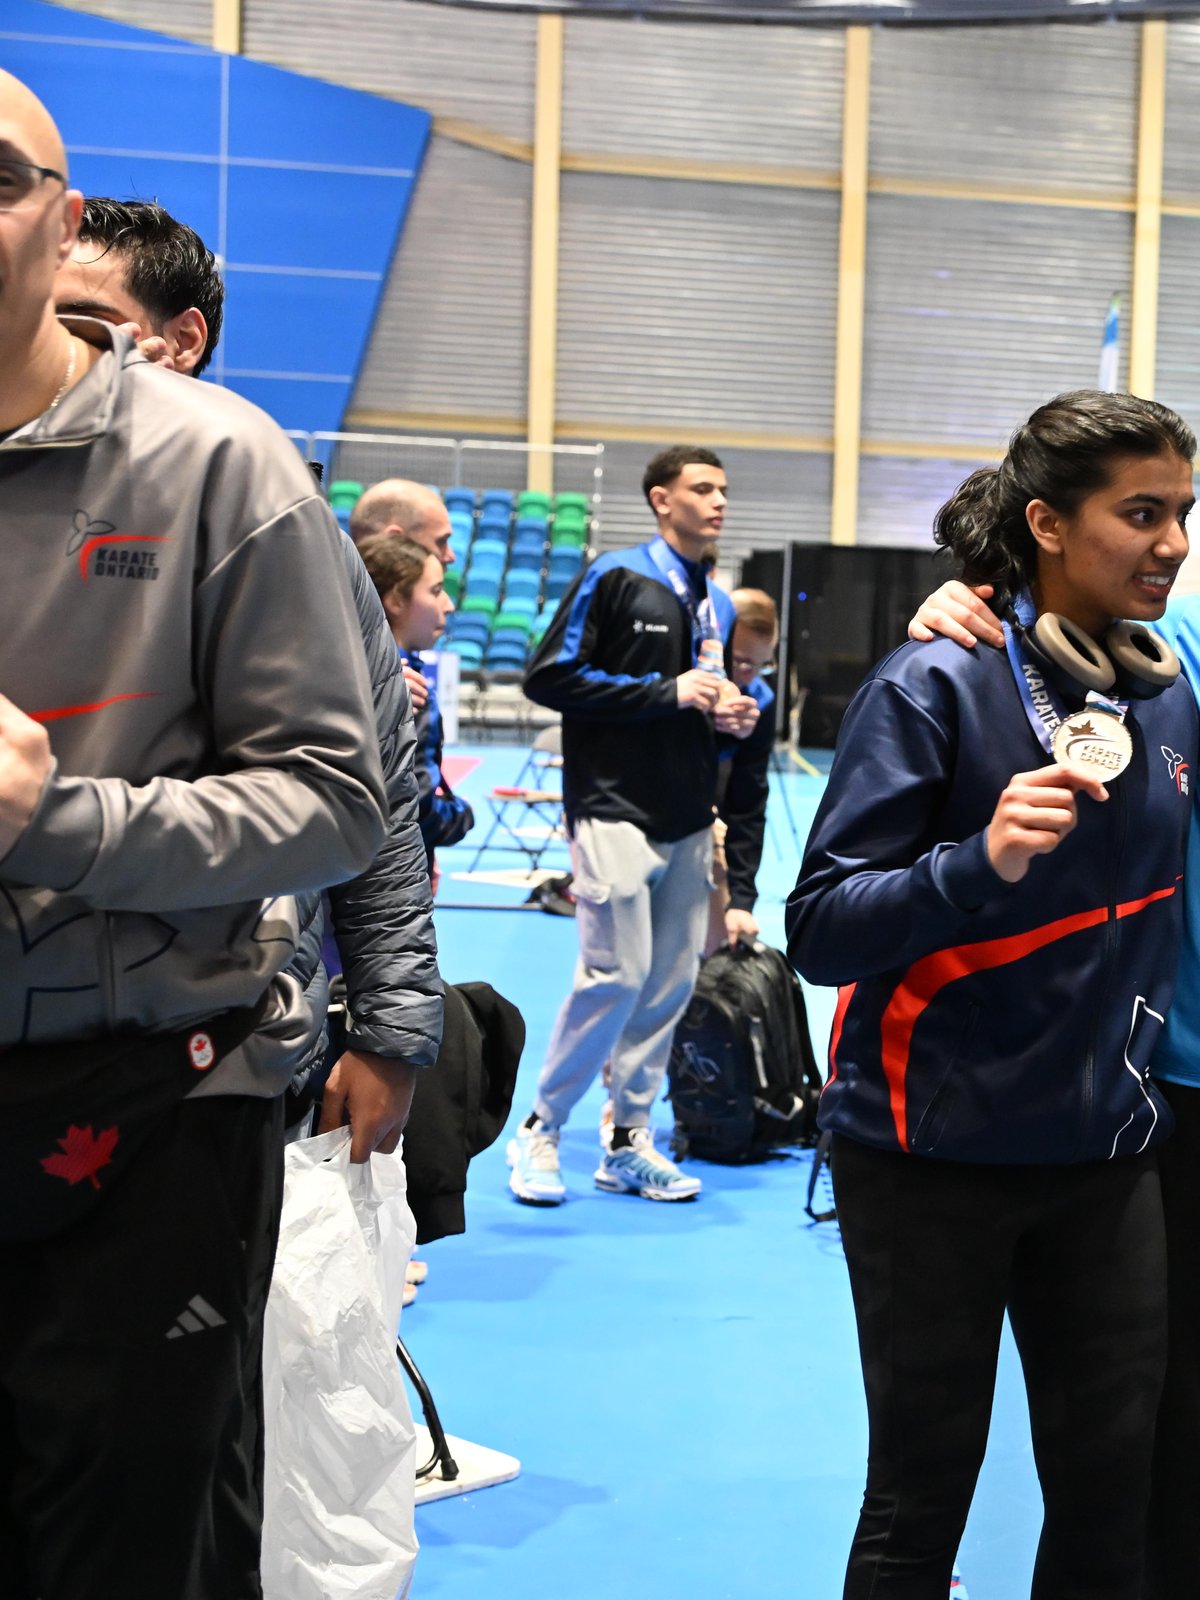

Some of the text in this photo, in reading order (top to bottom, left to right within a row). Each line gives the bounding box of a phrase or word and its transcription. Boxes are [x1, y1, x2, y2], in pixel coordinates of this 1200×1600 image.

[97, 549, 156, 566] KARATE
[95, 562, 159, 580] ONTARIO
[1022, 663, 1062, 732] KARATE
[1083, 745, 1123, 763] KARATE
